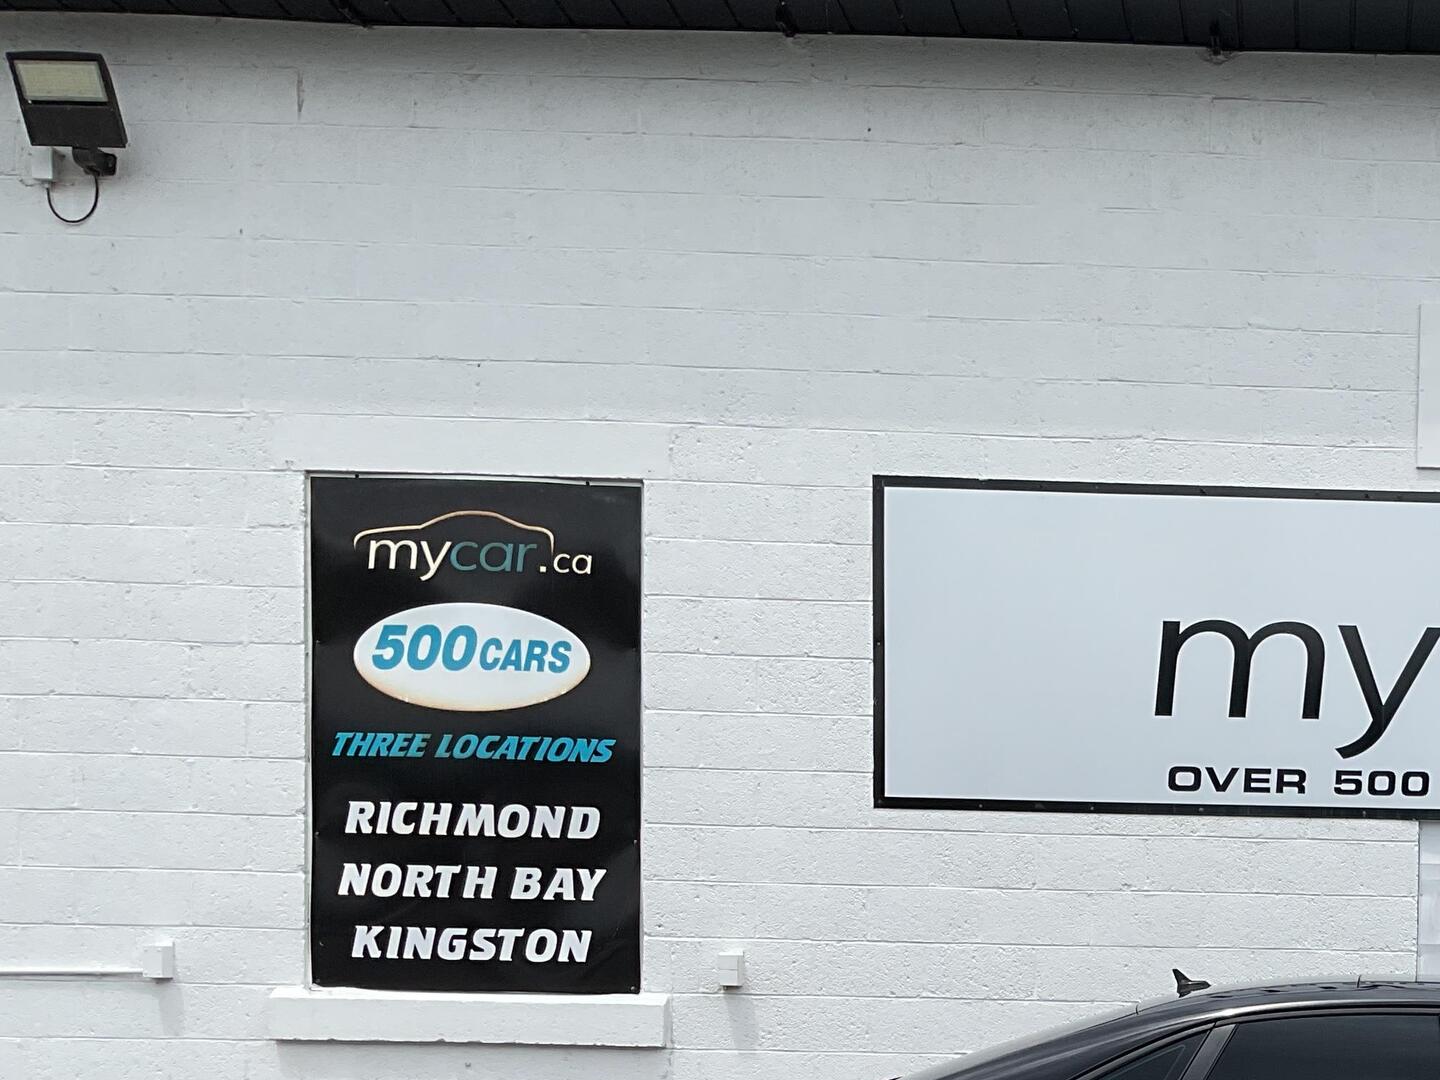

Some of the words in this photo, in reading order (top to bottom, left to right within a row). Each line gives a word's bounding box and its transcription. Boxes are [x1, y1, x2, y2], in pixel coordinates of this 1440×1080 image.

[367, 539, 593, 582] mycar.ca
[331, 731, 431, 758] THREE
[434, 734, 617, 763] LOCATIONS
[1167, 765, 1307, 795] OVER
[1333, 769, 1430, 797] 500
[344, 800, 601, 840] RICHMOND
[337, 862, 498, 899] NORTH
[509, 866, 607, 902] BAY
[351, 924, 593, 963] KINGSTON
